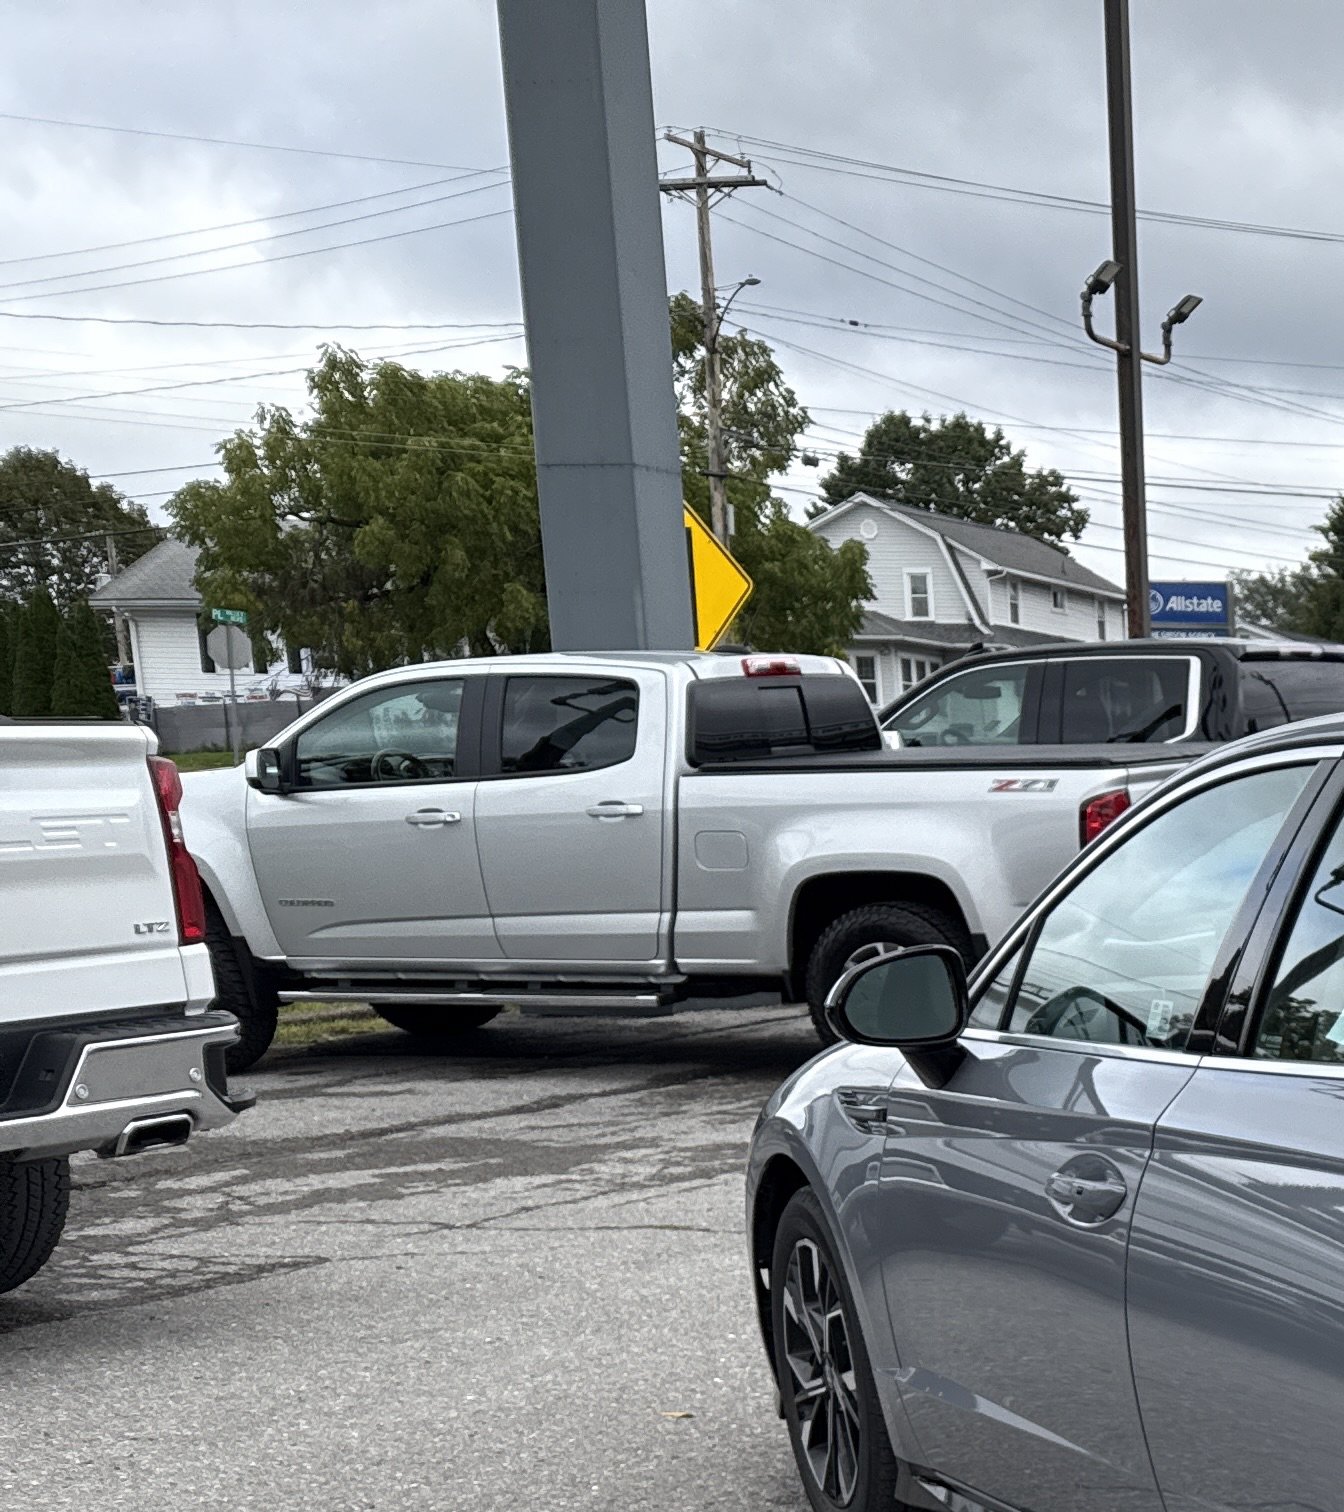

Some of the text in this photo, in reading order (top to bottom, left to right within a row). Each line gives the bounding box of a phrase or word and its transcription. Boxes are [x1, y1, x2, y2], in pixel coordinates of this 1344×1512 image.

[1165, 595, 1223, 613] Allstate
[987, 778, 1060, 793] Z71
[133, 921, 170, 935] LTZ
